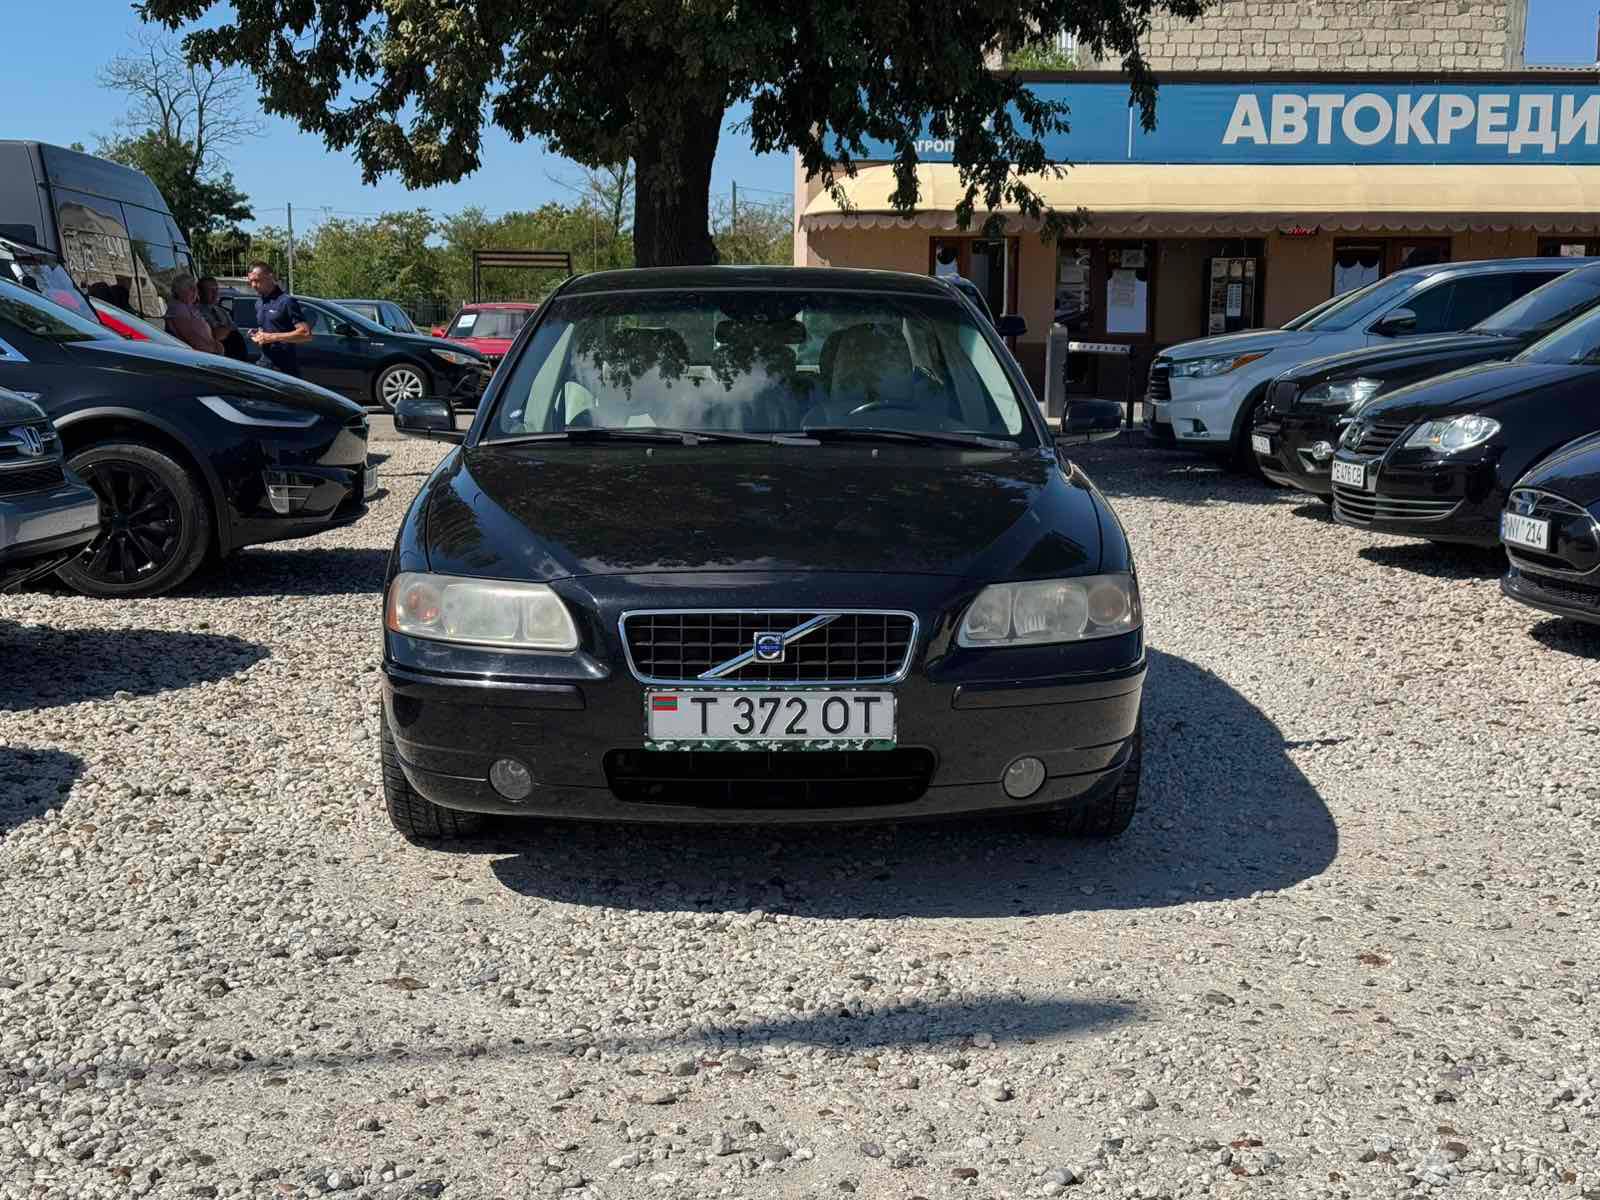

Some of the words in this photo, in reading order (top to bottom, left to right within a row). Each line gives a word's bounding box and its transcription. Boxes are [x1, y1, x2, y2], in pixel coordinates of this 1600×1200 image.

[690, 697, 718, 735] T
[732, 696, 808, 735] 372
[821, 695, 881, 735] OT
